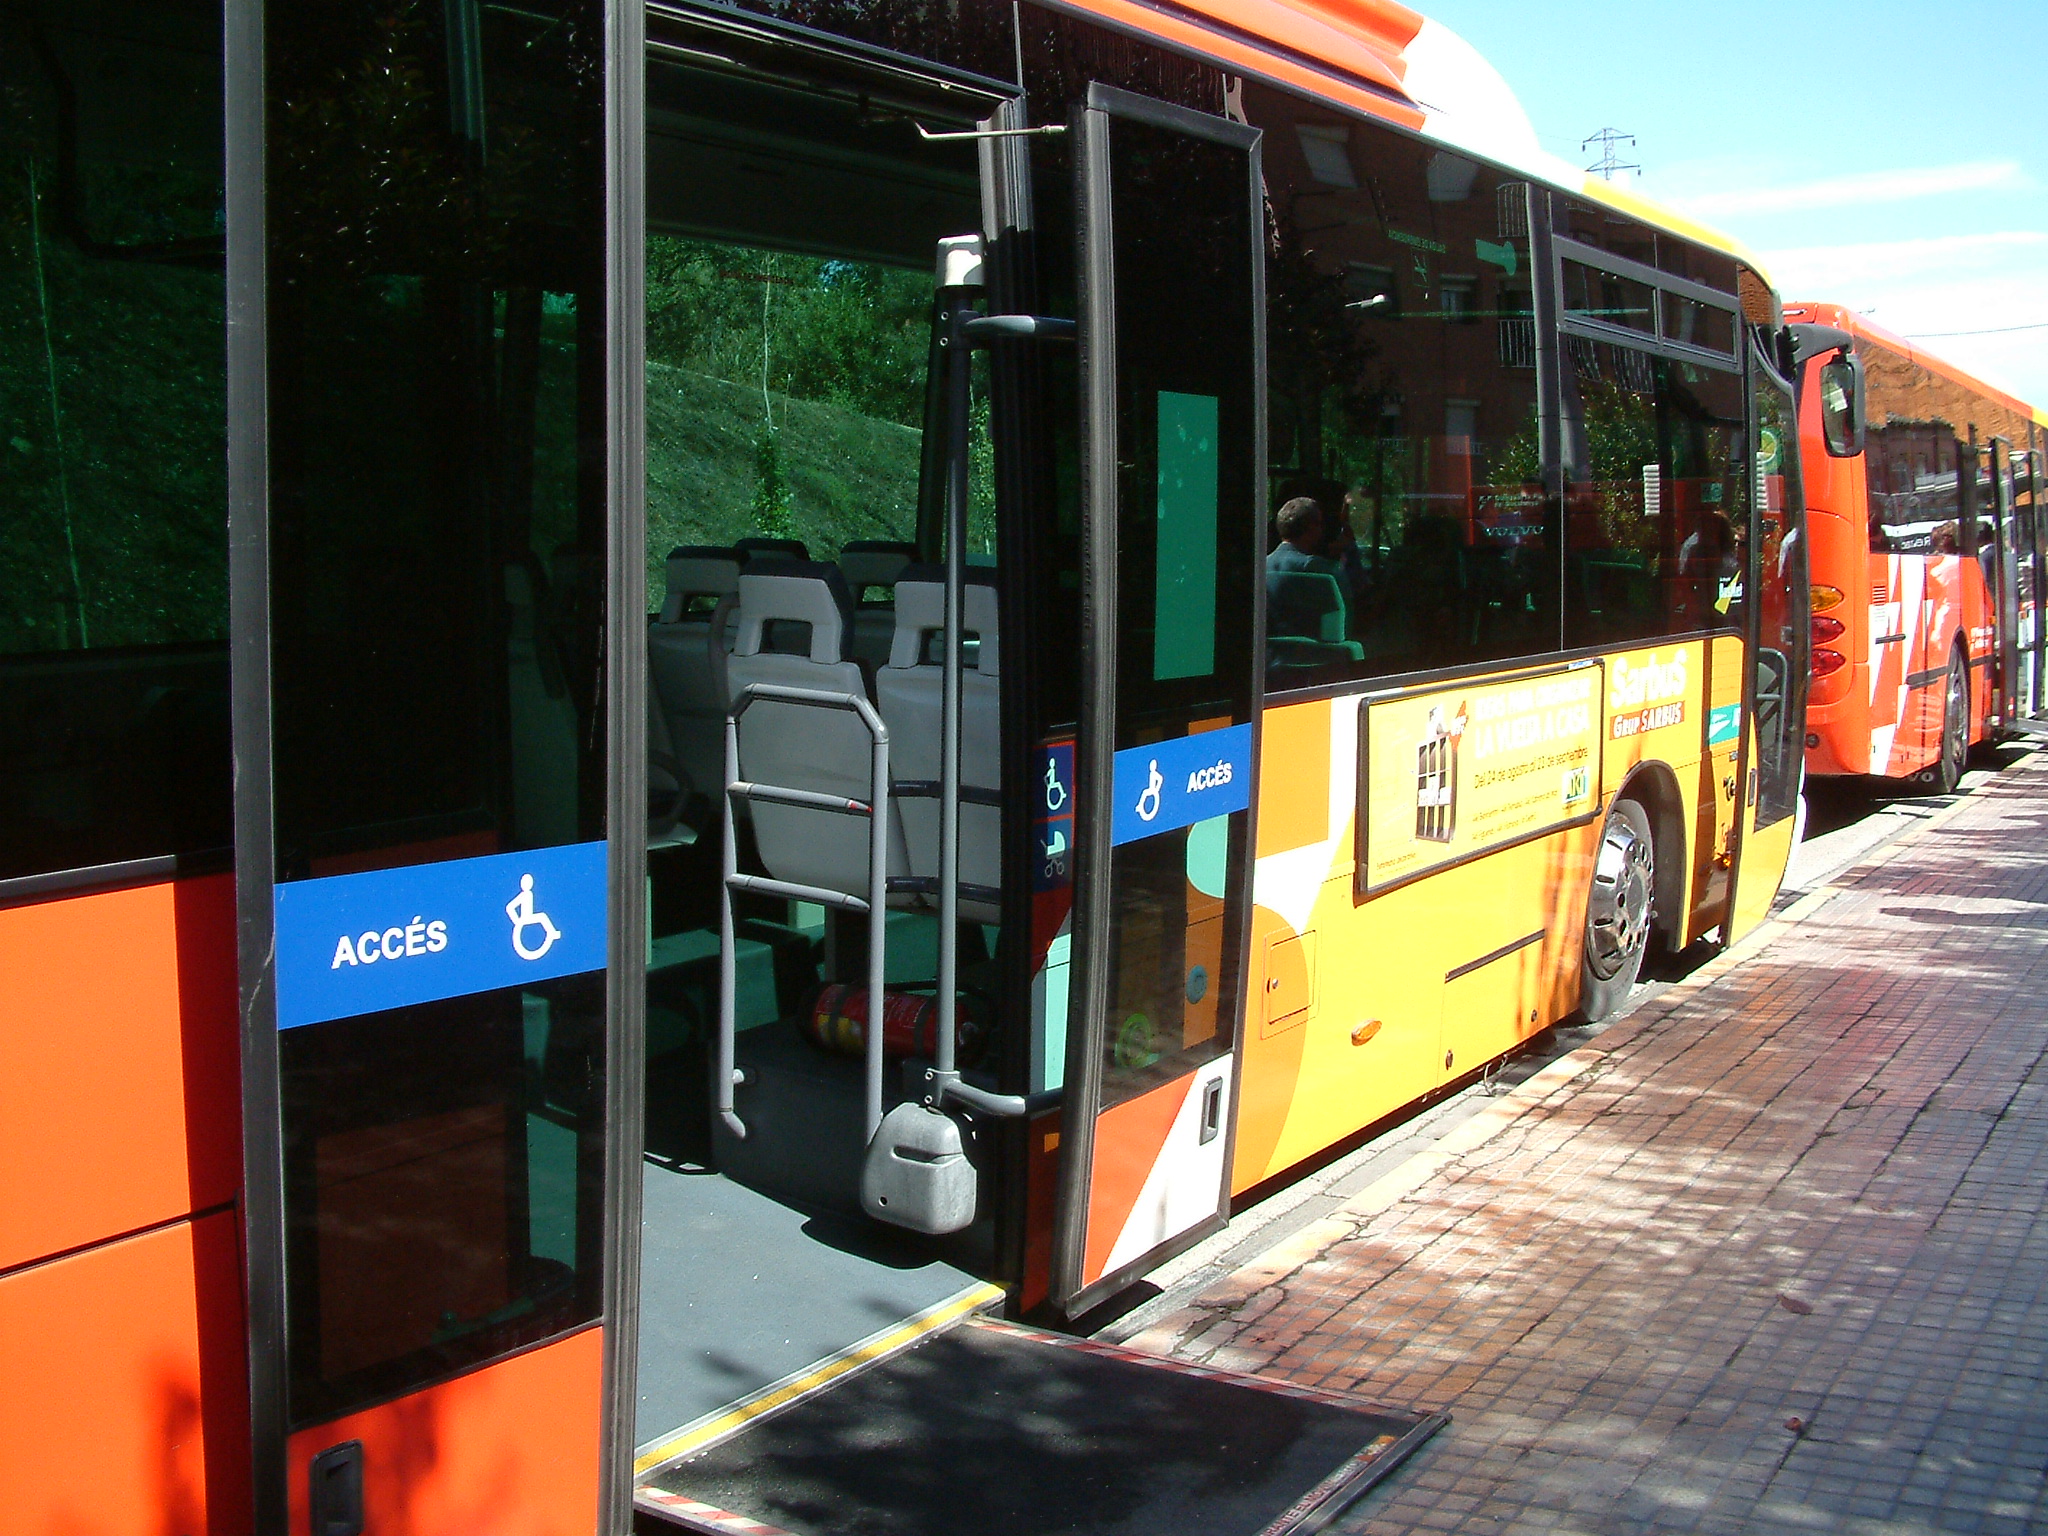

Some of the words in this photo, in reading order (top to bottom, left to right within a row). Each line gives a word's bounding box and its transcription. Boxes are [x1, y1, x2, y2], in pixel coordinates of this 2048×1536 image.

[1475, 725, 1495, 759] LA
[1543, 710, 1555, 741] A
[1556, 703, 1591, 738] CASA
[1641, 702, 1683, 732] SARBUS
[1186, 759, 1233, 794] ACCÉS
[331, 915, 448, 970] ACCÉS
